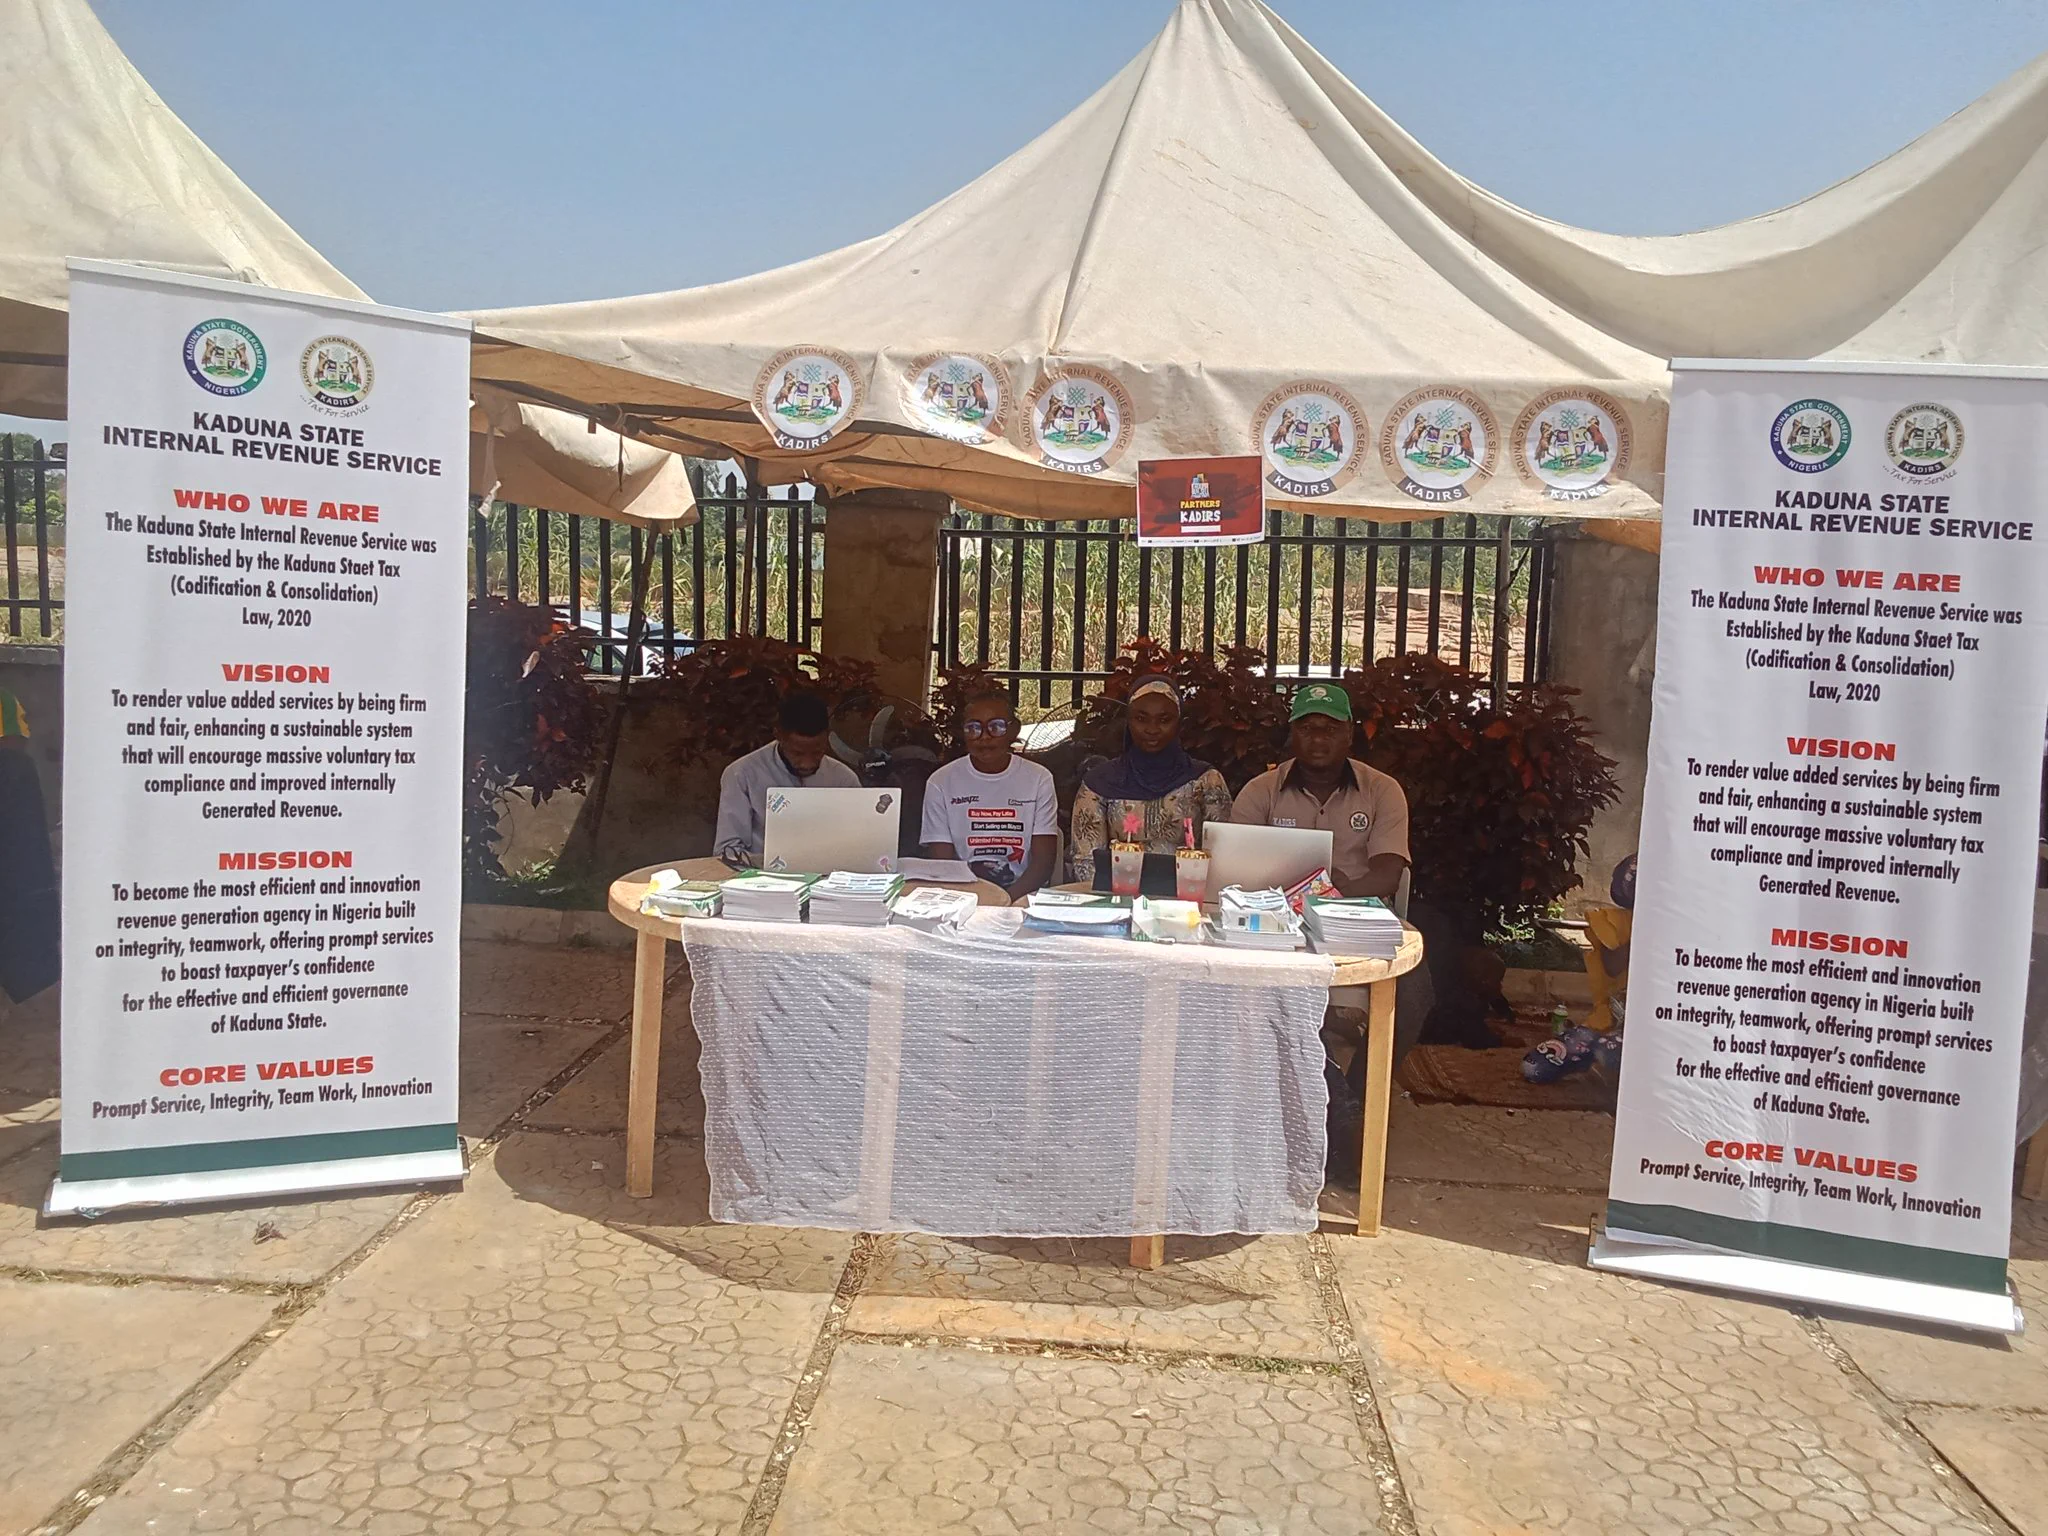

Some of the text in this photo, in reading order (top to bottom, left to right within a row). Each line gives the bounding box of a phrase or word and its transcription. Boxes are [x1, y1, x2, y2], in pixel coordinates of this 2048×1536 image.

[186, 322, 264, 370] KADUNA STATE GOVERNMENT
[783, 348, 861, 386] INTERNAL REVENUE
[204, 382, 248, 395] NIGERIA
[320, 395, 355, 406] KADIRS
[324, 406, 339, 417] For
[340, 405, 370, 418] Service
[1094, 372, 1131, 450] REVENUE SERVICE
[1773, 402, 1848, 444] KADUNA STATE GOVERNMENT
[194, 412, 364, 447] KADUNA STATE
[1260, 383, 1365, 474] STATE INTERNAL REVENUE SERVICE
[1383, 389, 1495, 466] KADUNA STATE INTERNAL REVENUE
[1513, 390, 1631, 480] KADUNA STATE INTERNAL REVENUE SERVICE
[104, 425, 441, 476] INTERNAL REVENUE SERVICE
[778, 434, 829, 449] KADIRS
[1047, 459, 1102, 473] KADIRS
[1788, 460, 1829, 472] NIGERIA
[1904, 464, 1941, 474] KADIRS
[1909, 476, 1923, 485] For
[1924, 469, 1957, 486] Service
[1274, 475, 1330, 495] KADIRS
[1405, 482, 1462, 500] KADIRS
[173, 489, 379, 523] WHO WE ARE
[1180, 500, 1221, 509] PARTNERS
[1775, 490, 1950, 514] KADUNA STATE
[1180, 510, 1221, 523] KADIRS
[1693, 508, 2033, 541] INTERNAL REVENUE SERVICE
[105, 511, 437, 553] The Kaduna State Internal Revenue Service was
[147, 544, 400, 578] Established by the Kaduna Staet Tax
[171, 574, 378, 606] (Codification & Consolidation)
[1754, 566, 1961, 593] WHO WE ARE
[242, 607, 312, 629] Law, 2020
[222, 664, 330, 684] VISION
[112, 688, 426, 715] To render value added services by being firm
[126, 716, 412, 741] and fair, enhancing a sustainable system
[122, 744, 416, 768] that will encourage massive voluntary tax
[1786, 737, 1896, 762] VISION
[144, 772, 396, 796] compliance and improved internally
[202, 799, 342, 819] Generated Revenue.
[219, 851, 352, 870] MISSION
[1771, 928, 1908, 959] MISSION
[1675, 948, 1981, 994] To become the most efficient and innovation
[1677, 981, 1974, 1022] revenue generation agency in Nigeria built
[1655, 1002, 1993, 1052] on integrity, teamwork, offering prompt services
[160, 1056, 374, 1087] CORE VALUES
[1676, 1057, 1960, 1106] for the effective and efficient governance
[93, 1077, 432, 1119] Prompt Service, Integrity, Team Work, Innovation
[1704, 1140, 1918, 1183] CORE VALUES
